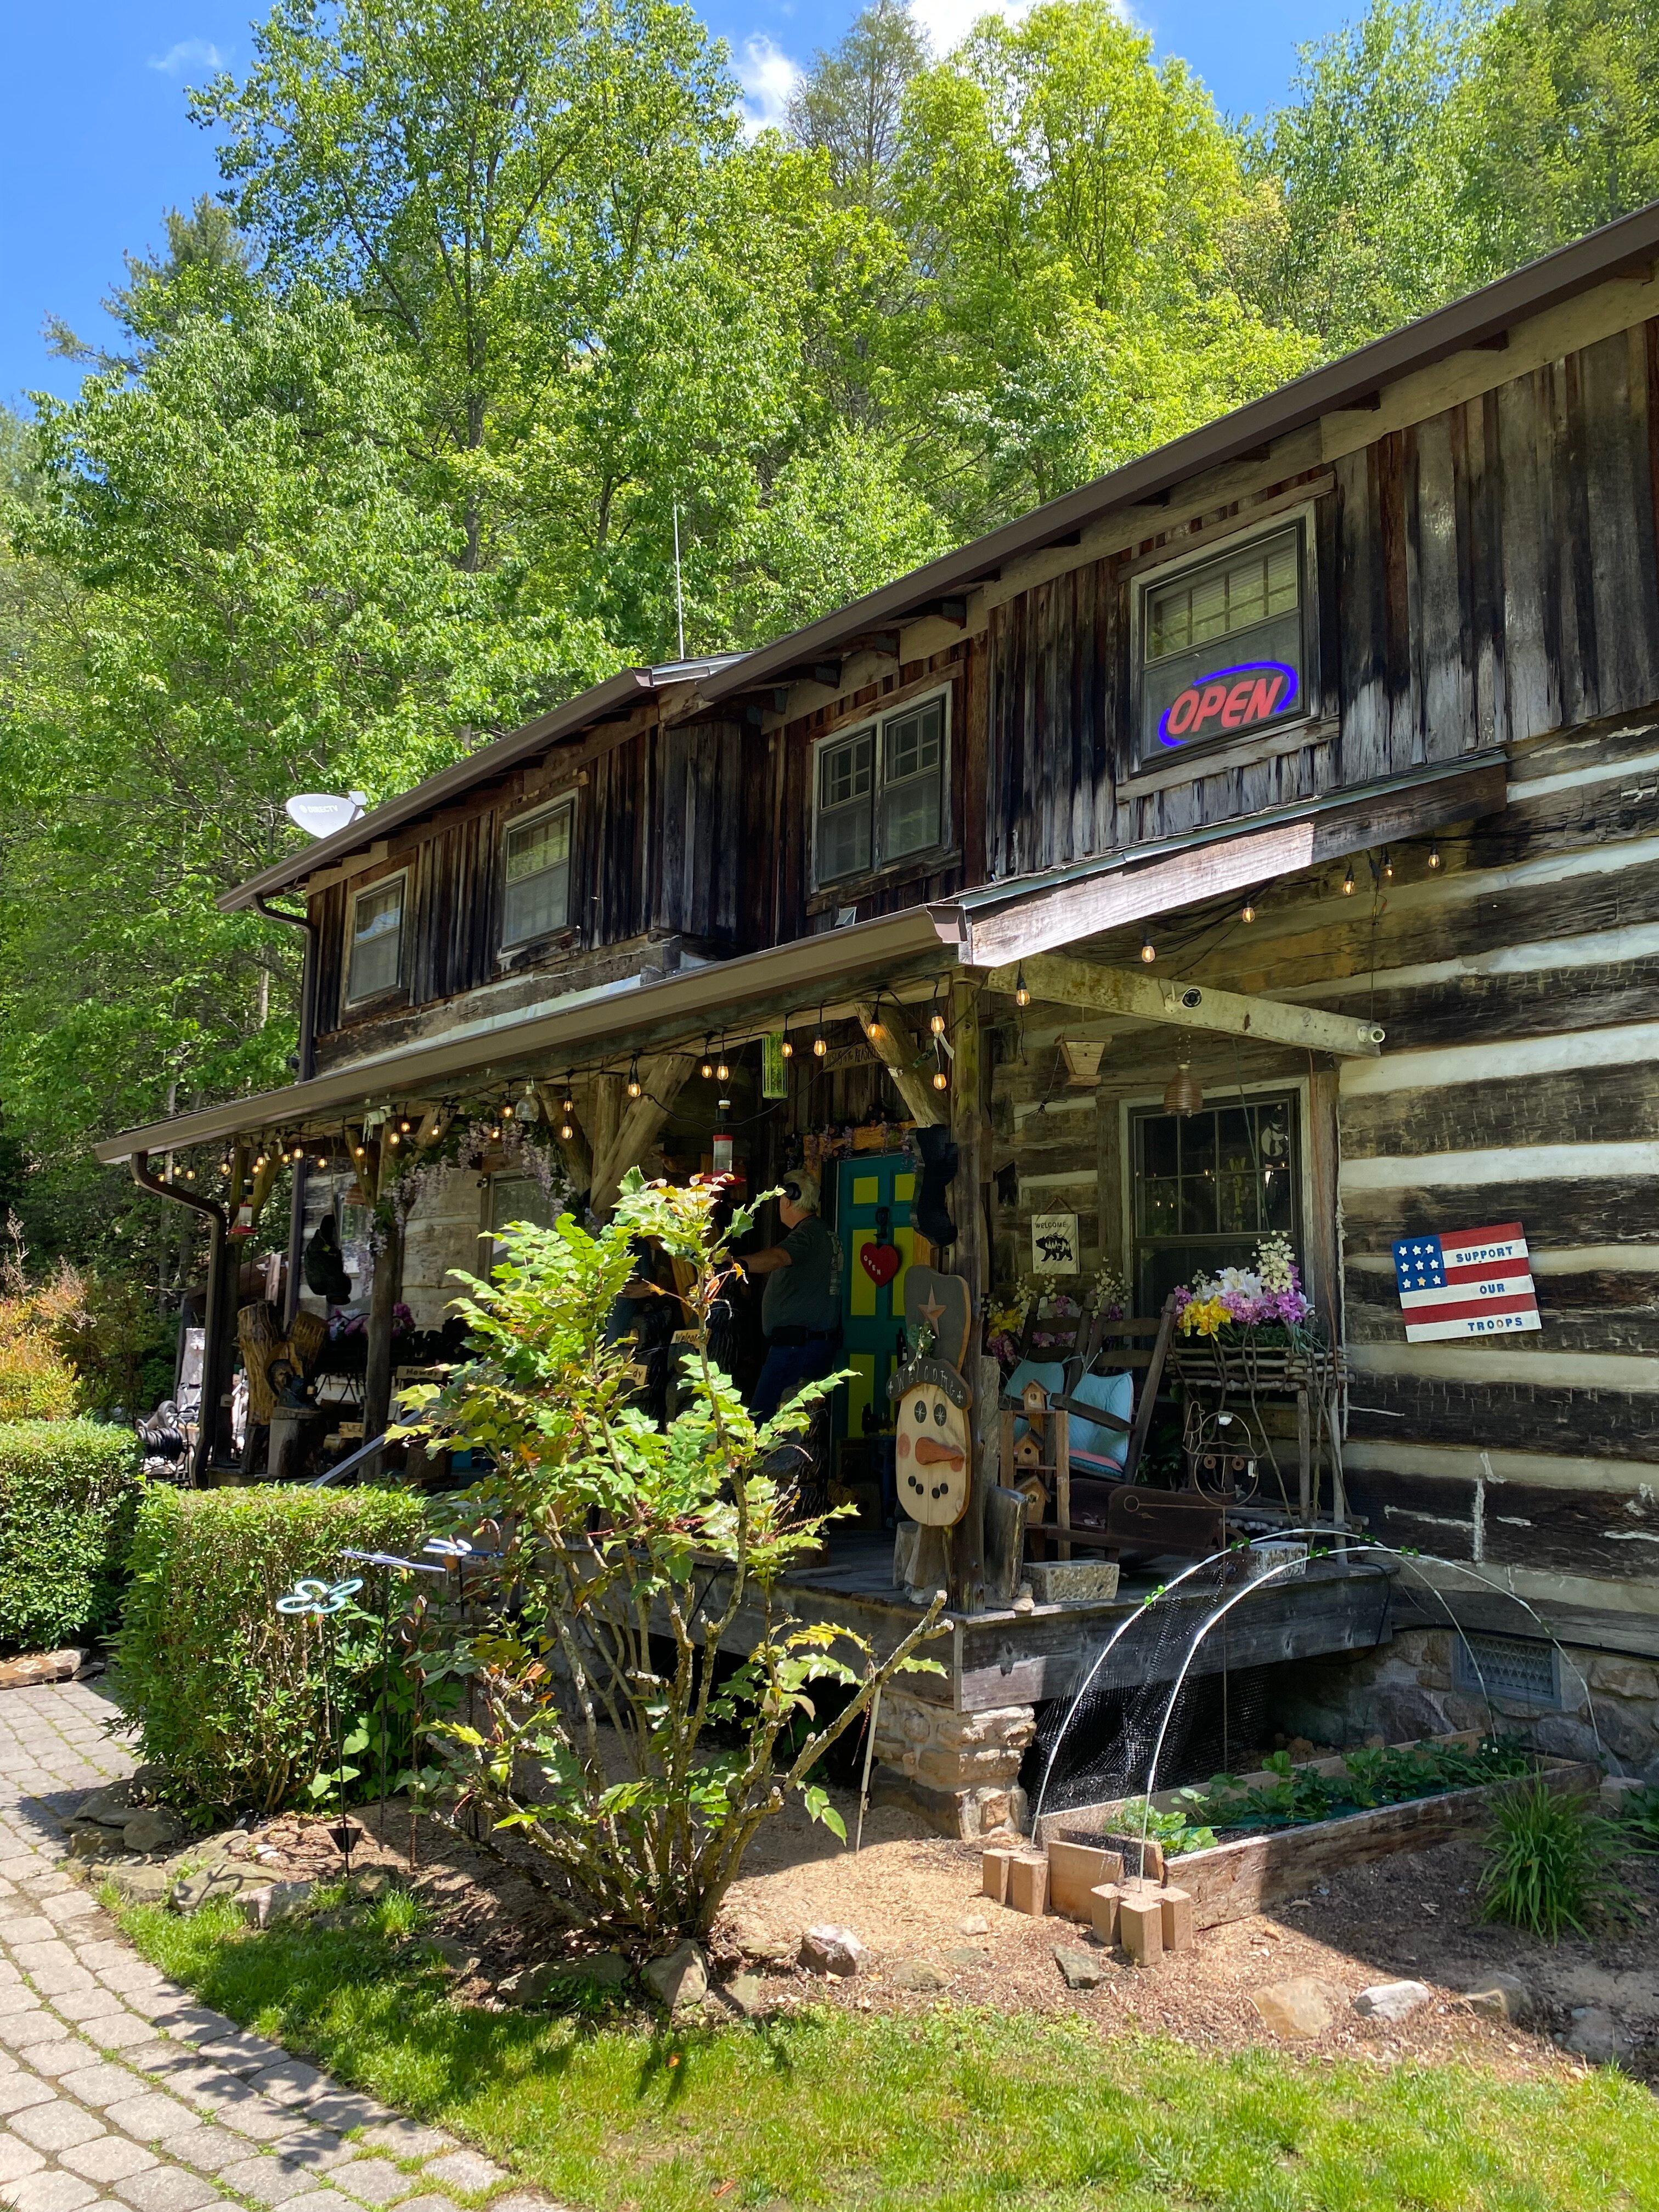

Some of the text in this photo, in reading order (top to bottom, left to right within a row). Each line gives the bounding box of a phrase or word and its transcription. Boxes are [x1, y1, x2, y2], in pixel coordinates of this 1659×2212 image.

[1167, 675, 1283, 735] OPEN
[307, 805, 338, 813] DIRECTV
[1455, 1246, 1513, 1262] SUPPORT
[864, 1255, 881, 1276] OPEN
[1480, 1283, 1505, 1294] OUR
[1468, 1317, 1522, 1331] TROOPS
